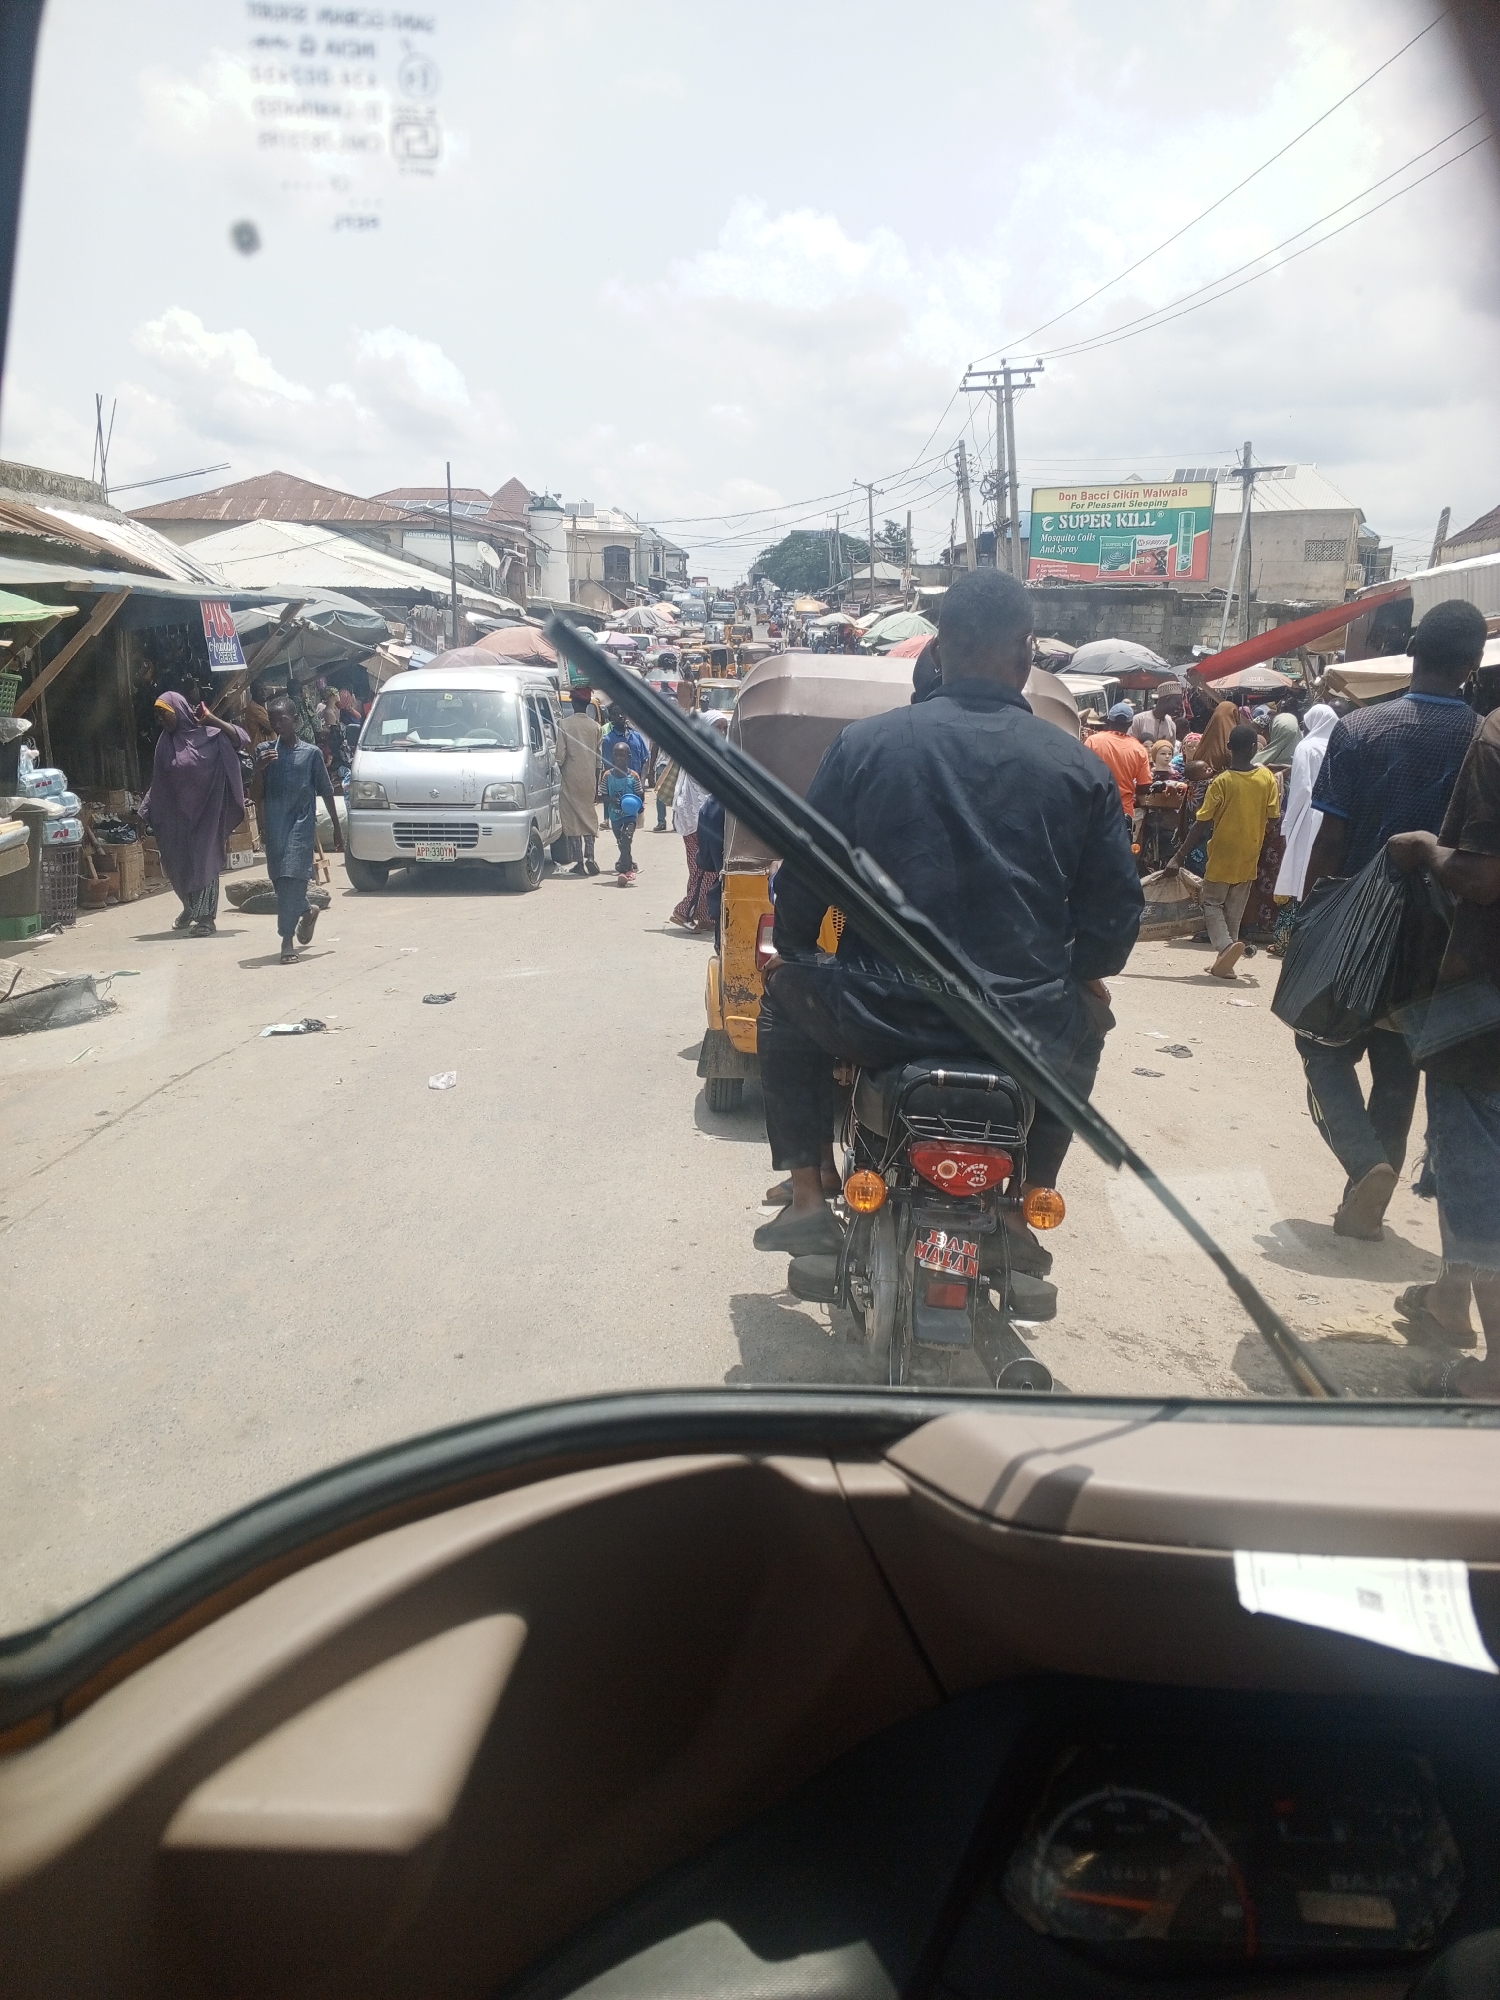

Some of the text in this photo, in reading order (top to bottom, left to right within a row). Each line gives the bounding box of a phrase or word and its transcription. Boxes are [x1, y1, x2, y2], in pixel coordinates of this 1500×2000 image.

[1059, 486, 1187, 501] Don Bacci Cikin Walwala
[1070, 499, 1168, 510] For Pleasant Sleeping
[1058, 511, 1156, 530] SUPER KILL
[1041, 532, 1095, 544] Mosquito Coils
[1040, 544, 1078, 555] And Spray
[219, 651, 238, 664] HERE
[927, 1229, 977, 1259] DAN
[914, 1240, 978, 1280] MALAN
